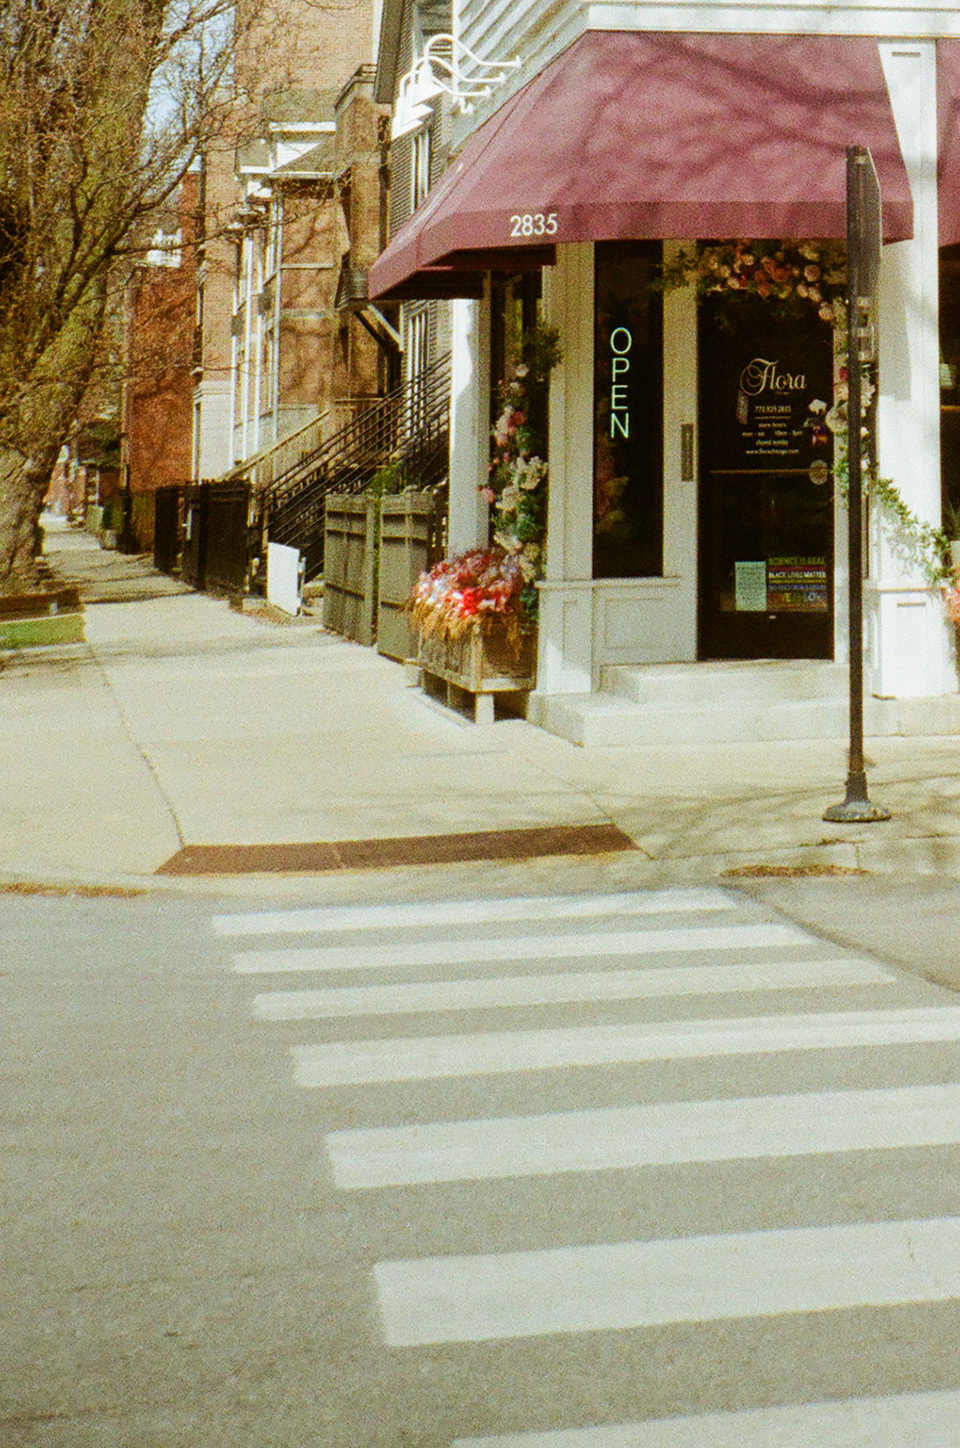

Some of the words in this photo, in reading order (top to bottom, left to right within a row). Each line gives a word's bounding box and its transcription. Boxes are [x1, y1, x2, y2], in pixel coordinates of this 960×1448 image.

[510, 213, 558, 236] 2835
[610, 326, 632, 439] OPEN
[740, 358, 807, 396] Flora
